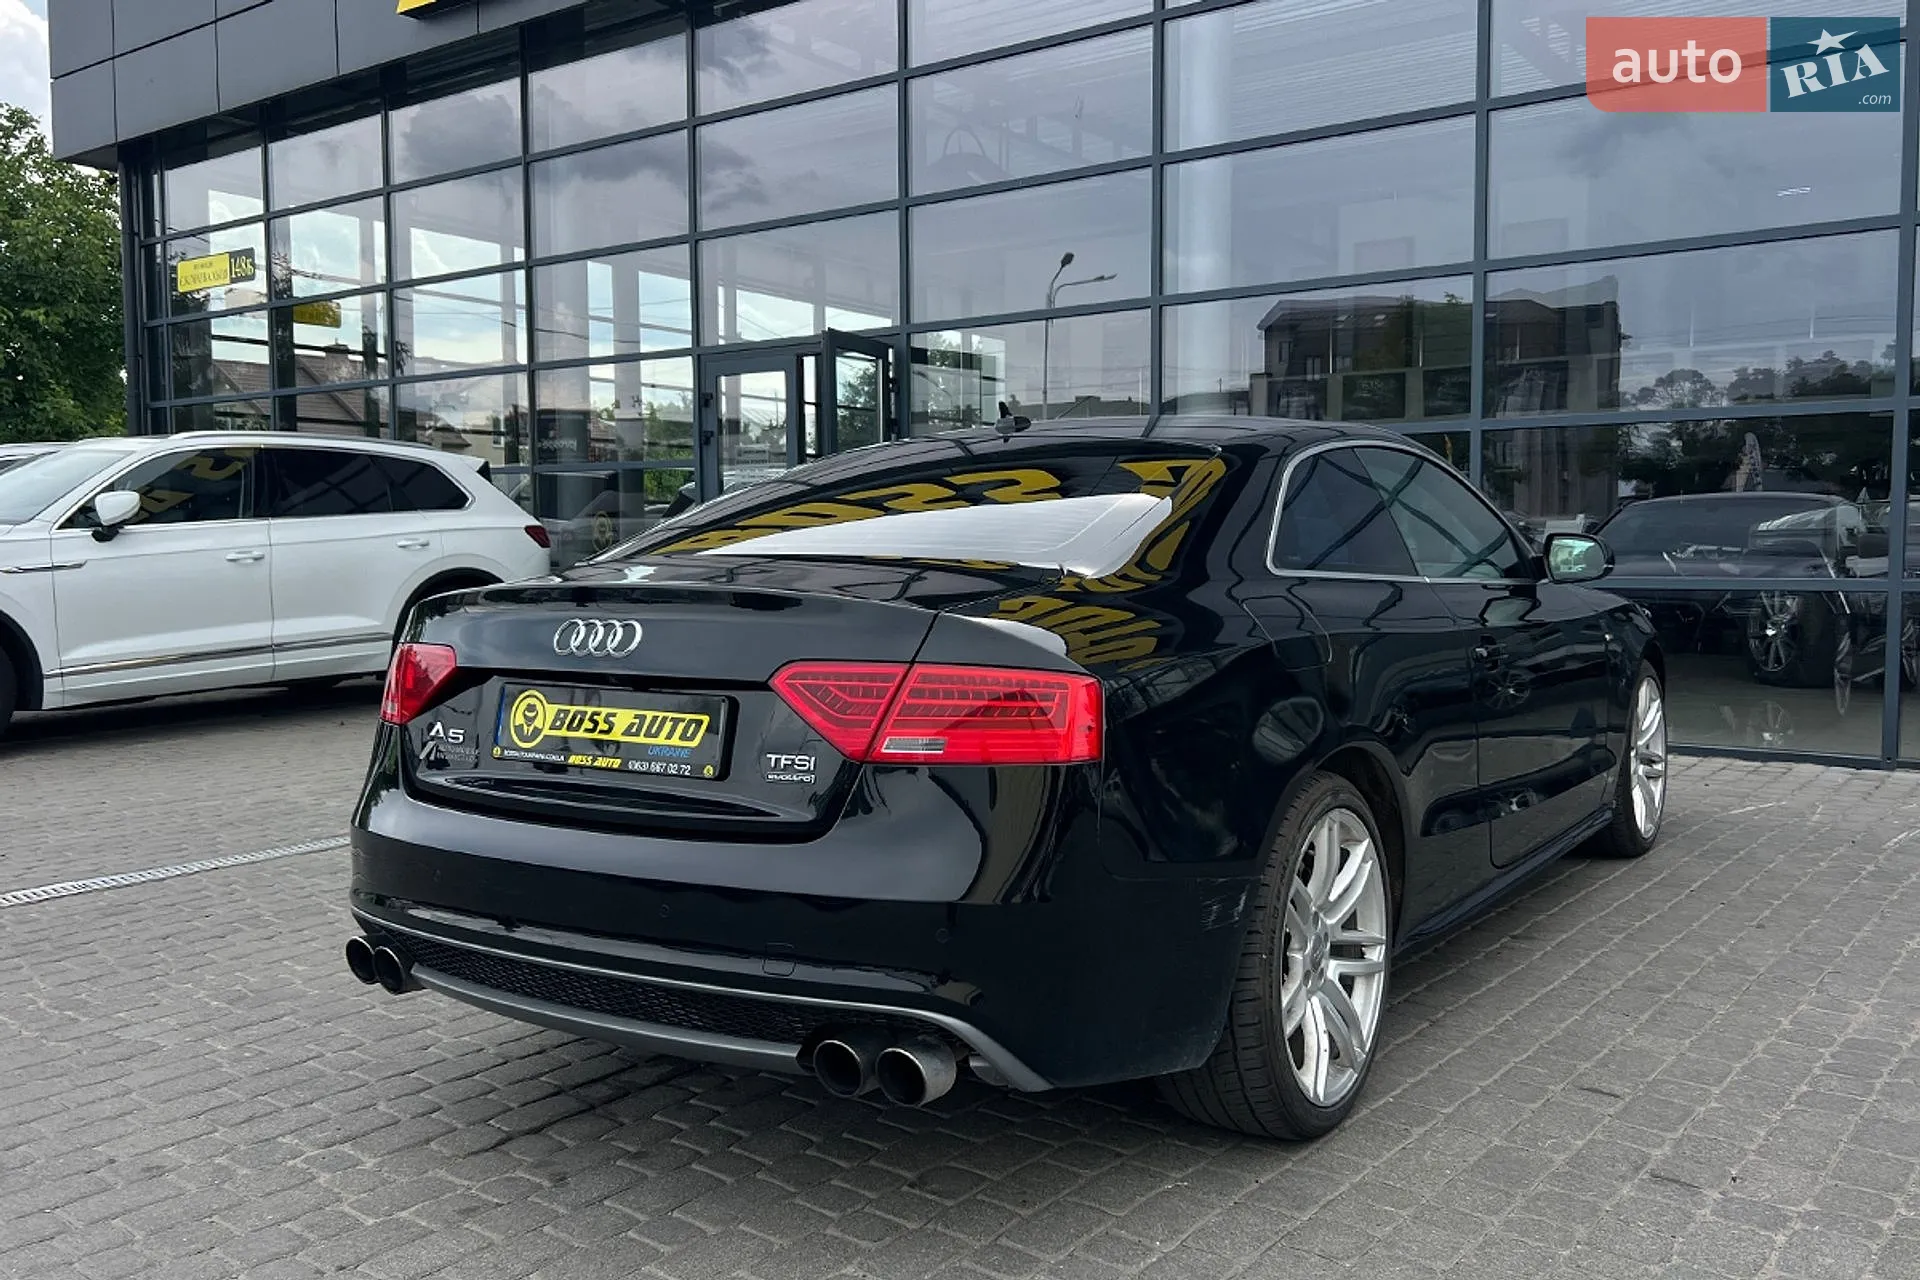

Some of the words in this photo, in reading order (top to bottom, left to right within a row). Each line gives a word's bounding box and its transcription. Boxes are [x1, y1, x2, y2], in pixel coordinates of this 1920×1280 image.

[429, 721, 465, 744] A5
[549, 709, 618, 734] BOSS
[621, 713, 704, 742] AUTO
[568, 754, 593, 765] BOSS
[593, 756, 622, 768] AUTO
[680, 764, 692, 776] 72
[766, 753, 816, 771] TFSI
